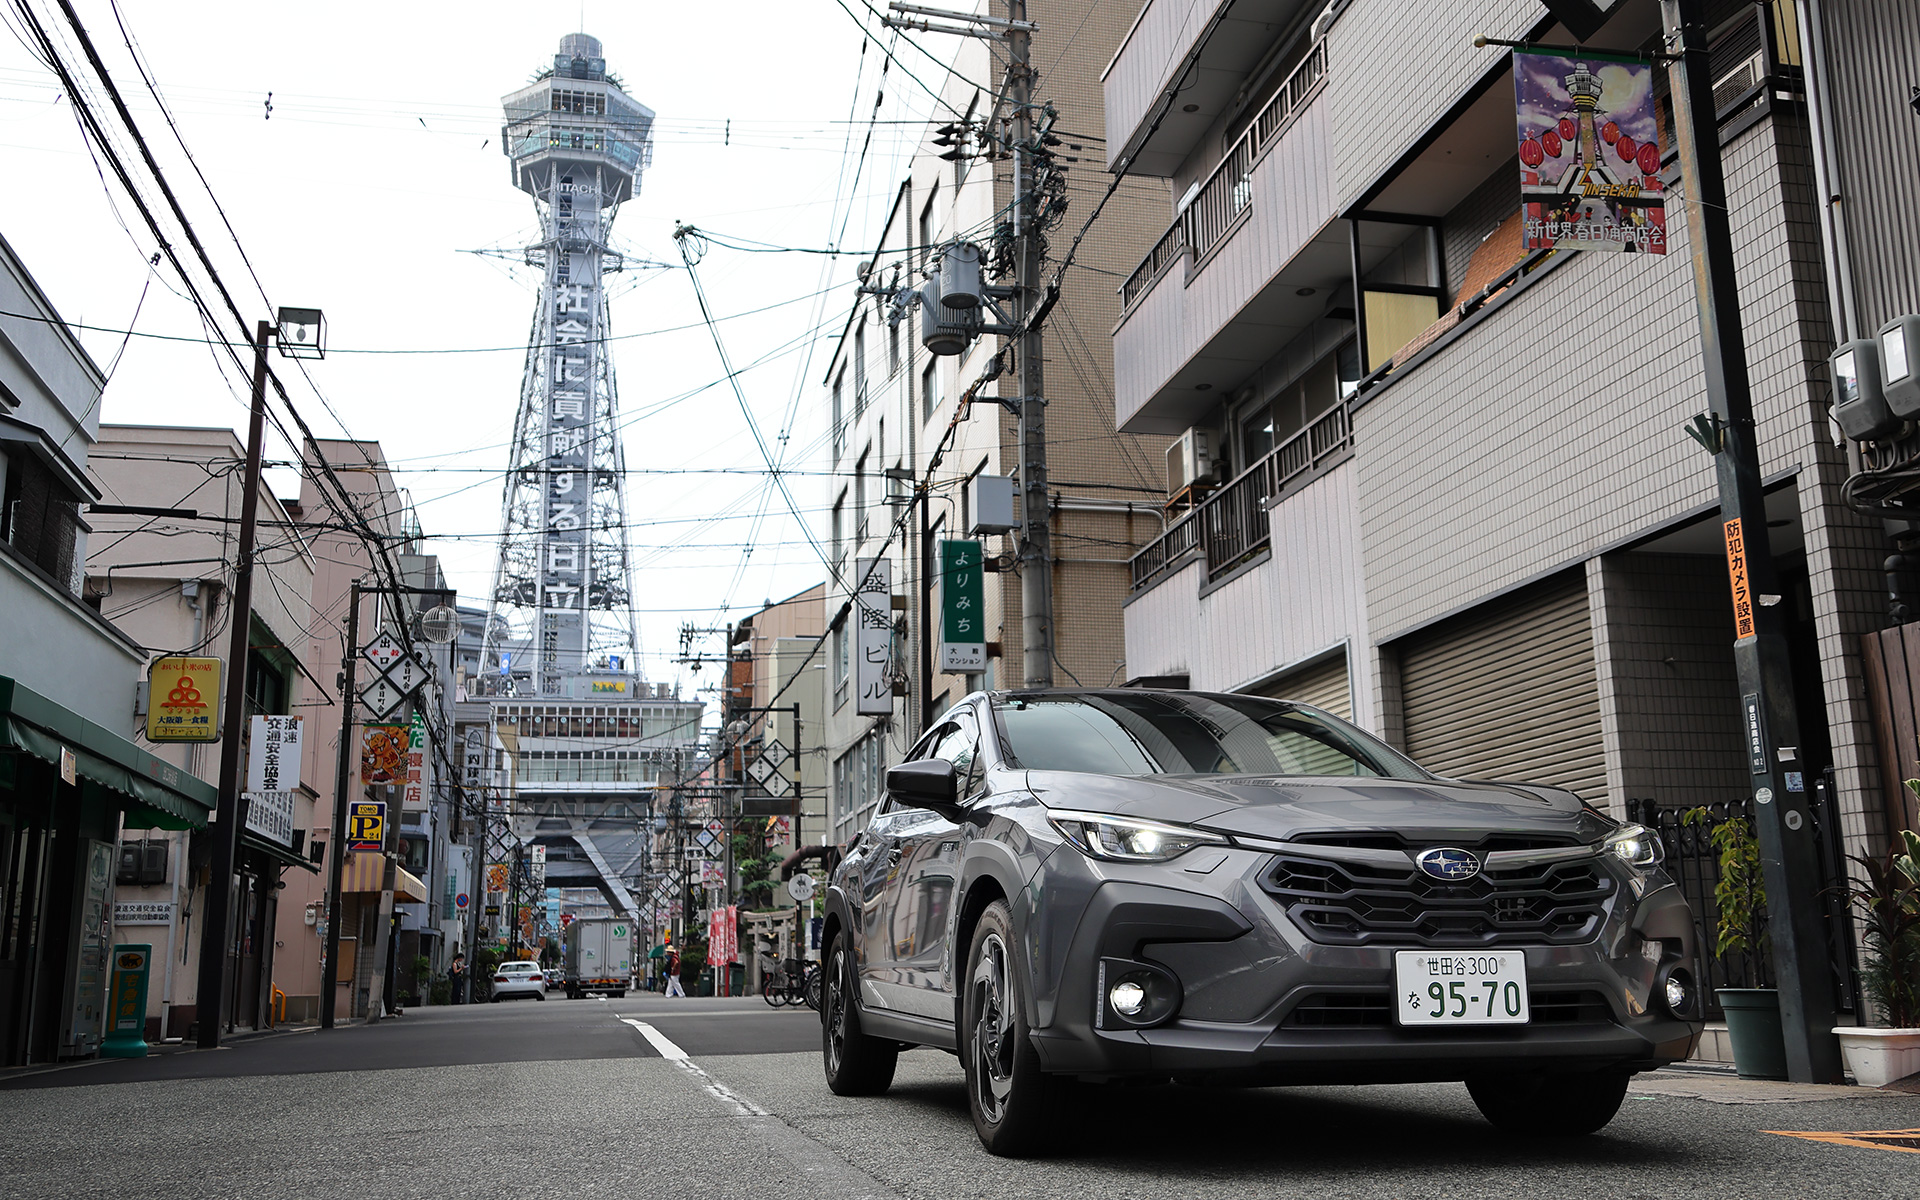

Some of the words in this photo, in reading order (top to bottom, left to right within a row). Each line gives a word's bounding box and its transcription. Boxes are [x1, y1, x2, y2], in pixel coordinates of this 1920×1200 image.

[1527, 220, 1665, 246] 新世界春日通商店会
[543, 284, 589, 614] 社会に貢献する日立
[955, 552, 971, 633] よりみち
[1726, 521, 1753, 636] 防犯カメラ設置
[379, 637, 391, 665] 出口
[860, 573, 889, 700] 盛隆ビル
[161, 663, 212, 672] おいしい米の店
[402, 658, 411, 690] 春日町会
[949, 658, 981, 666] マンション
[377, 682, 387, 713] 春日町会
[157, 716, 209, 725] 大阪第一食糧
[284, 718, 298, 744] 浪速
[263, 717, 282, 791] 交通安全協会
[353, 817, 380, 839] P
[120, 973, 139, 1016] 宅急便
[1408, 991, 1422, 1010] な
[1427, 981, 1521, 1018] 95-70
